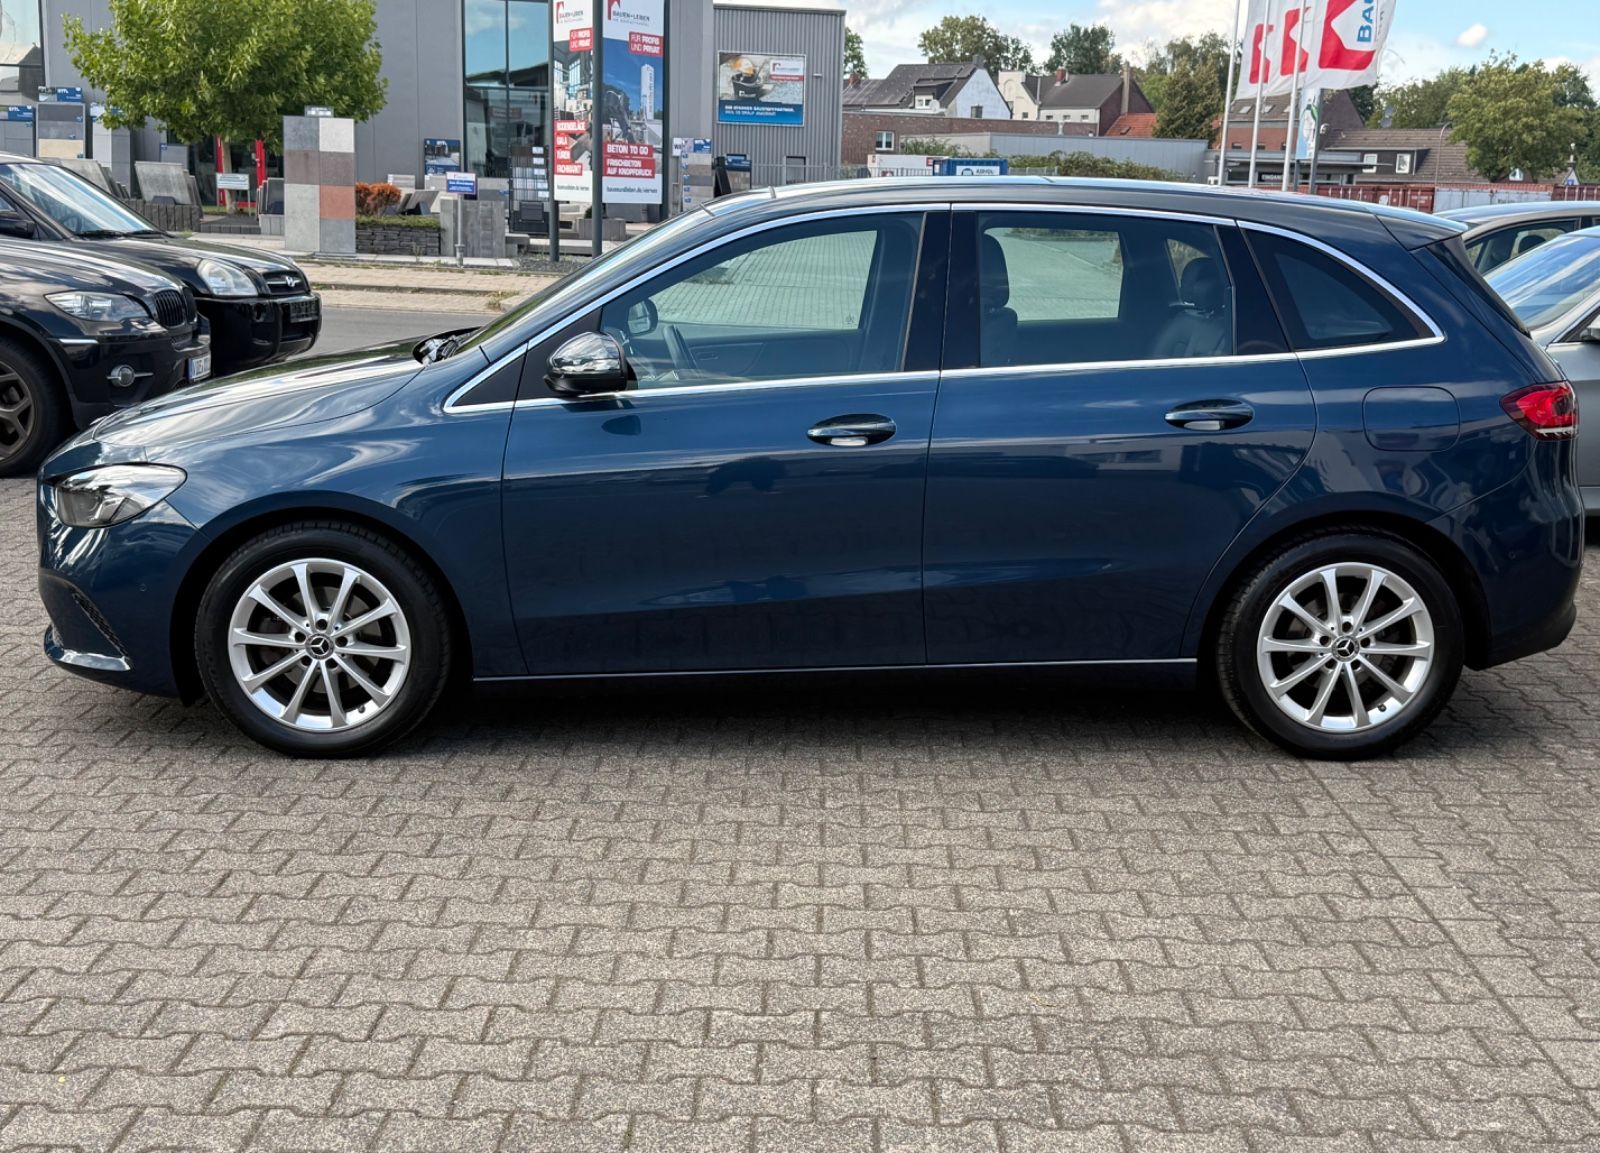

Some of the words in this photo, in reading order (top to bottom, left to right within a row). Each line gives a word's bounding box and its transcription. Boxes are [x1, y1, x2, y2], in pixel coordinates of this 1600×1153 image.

[1357, 0, 1374, 42] BA
[606, 144, 628, 154] BETON
[630, 146, 638, 155] TO
[639, 146, 649, 155] GO
[606, 158, 642, 168] FRISCHBETON
[606, 167, 618, 176] AUF
[618, 168, 653, 177] KNOPFDRUCK
